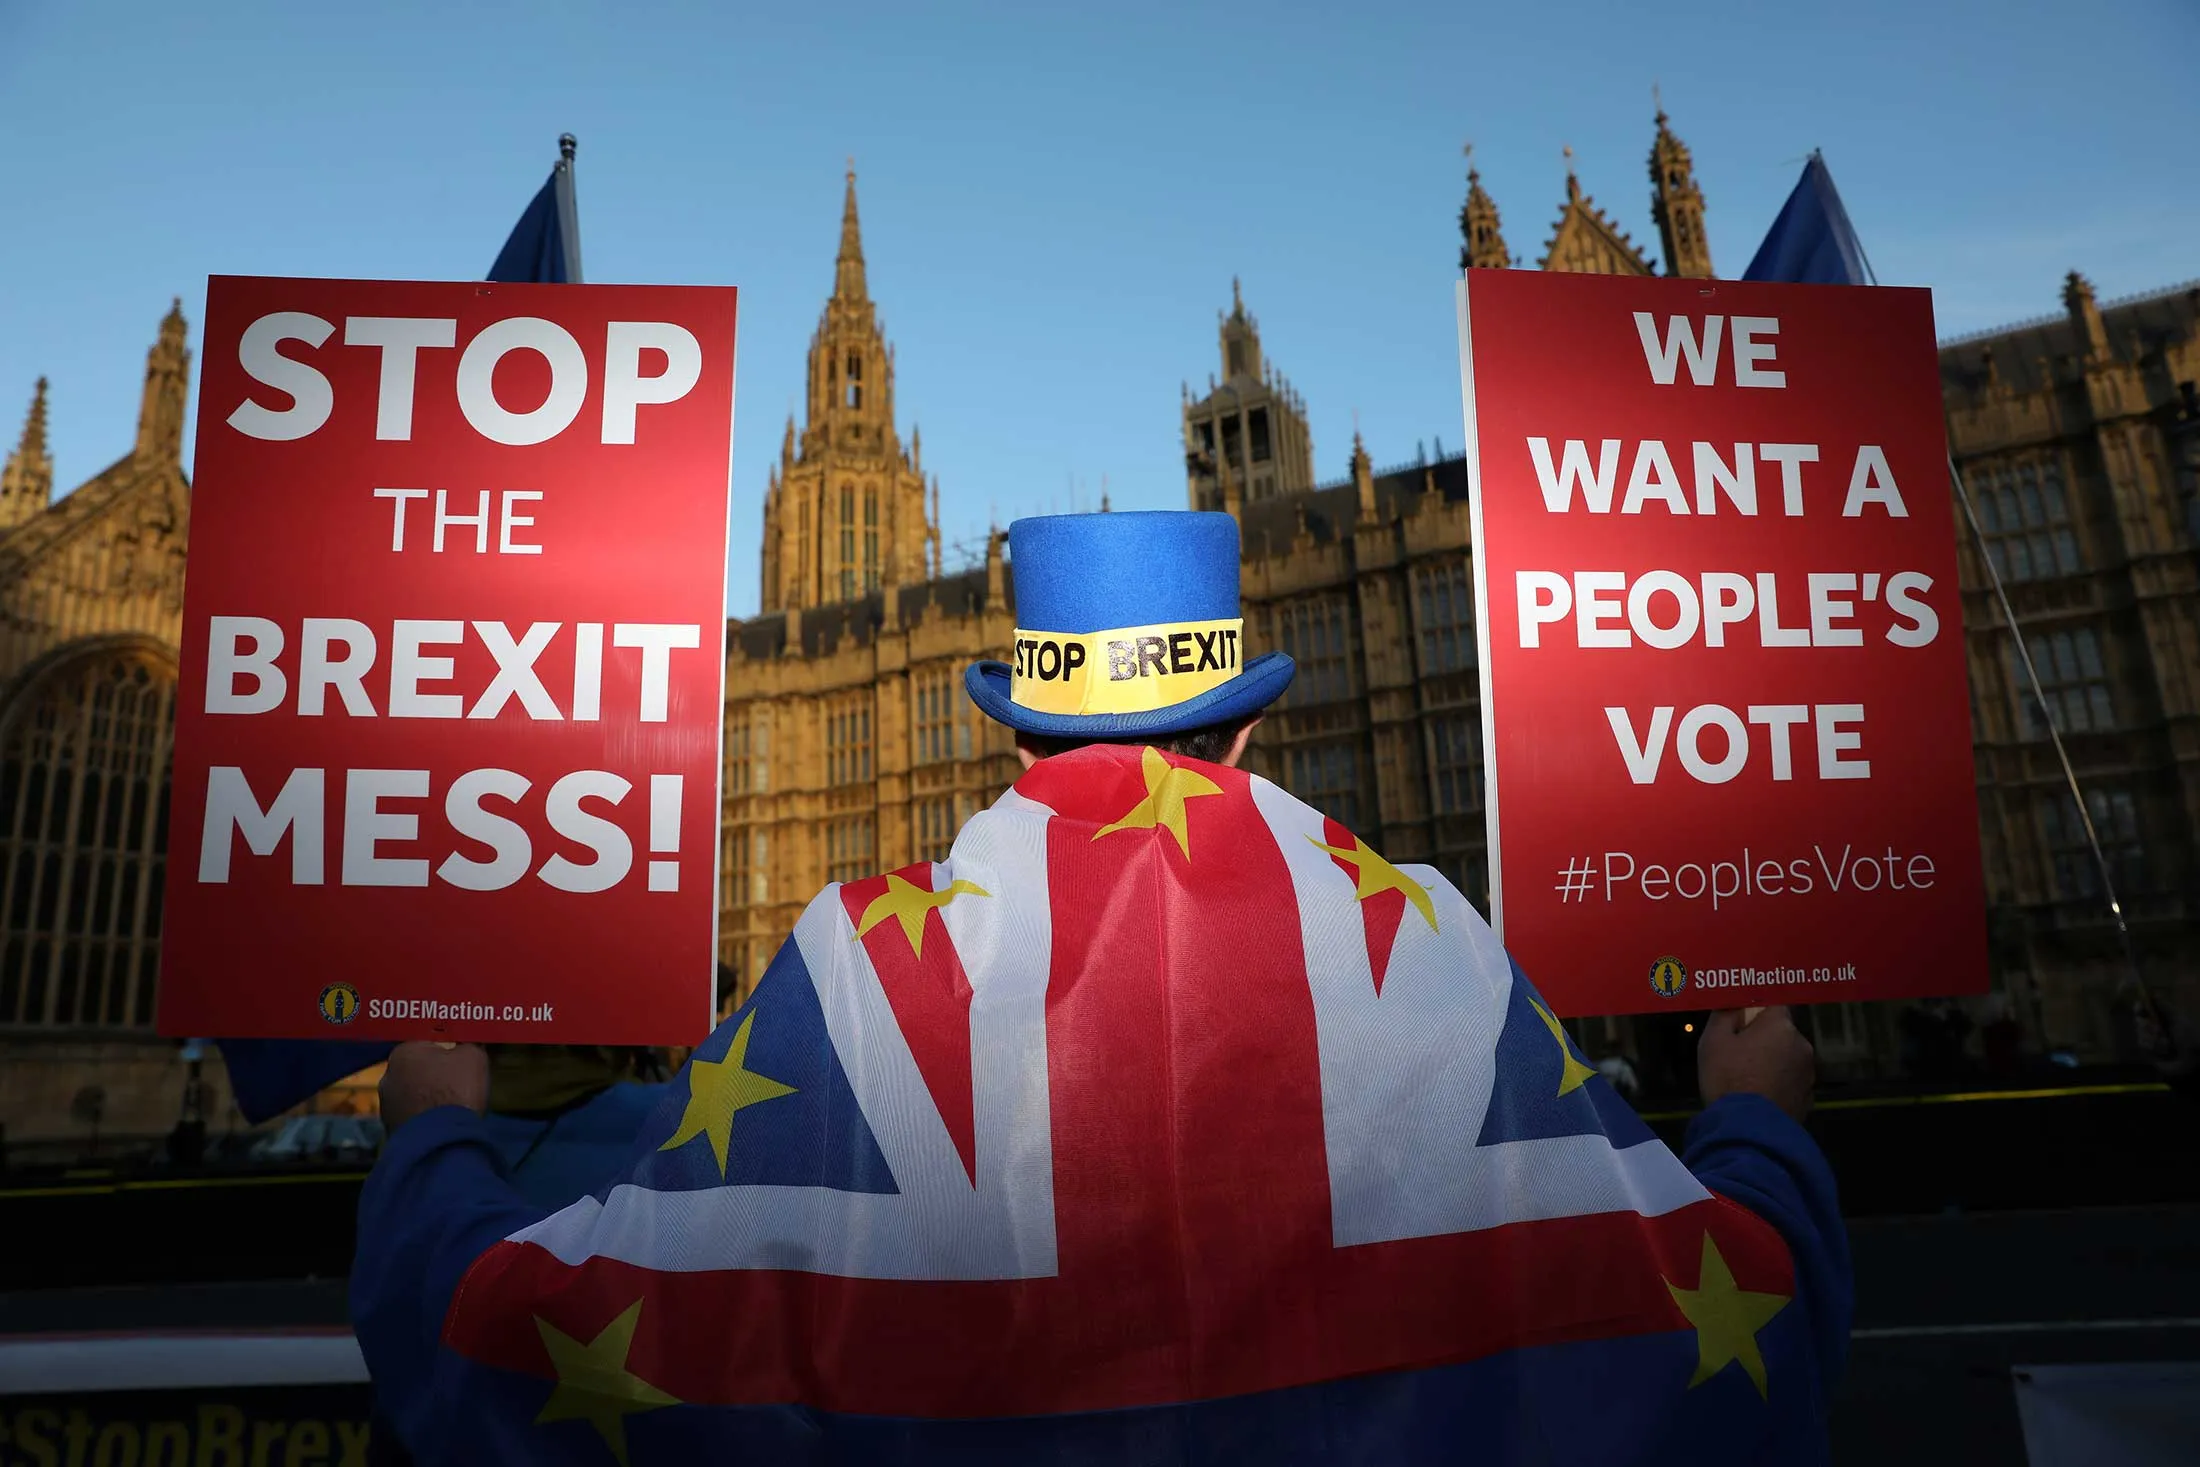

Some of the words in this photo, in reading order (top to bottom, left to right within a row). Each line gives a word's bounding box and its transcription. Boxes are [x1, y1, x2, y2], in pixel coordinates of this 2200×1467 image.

[226, 311, 703, 446] STOP
[1632, 311, 1787, 389] WE
[1526, 436, 1820, 517] WANT
[1842, 445, 1910, 518] A
[373, 488, 544, 555] THE
[1515, 569, 1940, 650] PEOPLE'S
[205, 616, 701, 723] BREXIT
[1015, 637, 1086, 682] STOP
[1107, 629, 1238, 682] BREXIT
[1603, 703, 1871, 785] VOTE
[198, 766, 684, 893] MESS!
[1554, 845, 1937, 911] #PeoplesVote
[368, 999, 554, 1022] SODEMaction.co.uk
[1694, 962, 1857, 989] SODEMaction.co.uk
[0, 1402, 371, 1467] StopBrex
